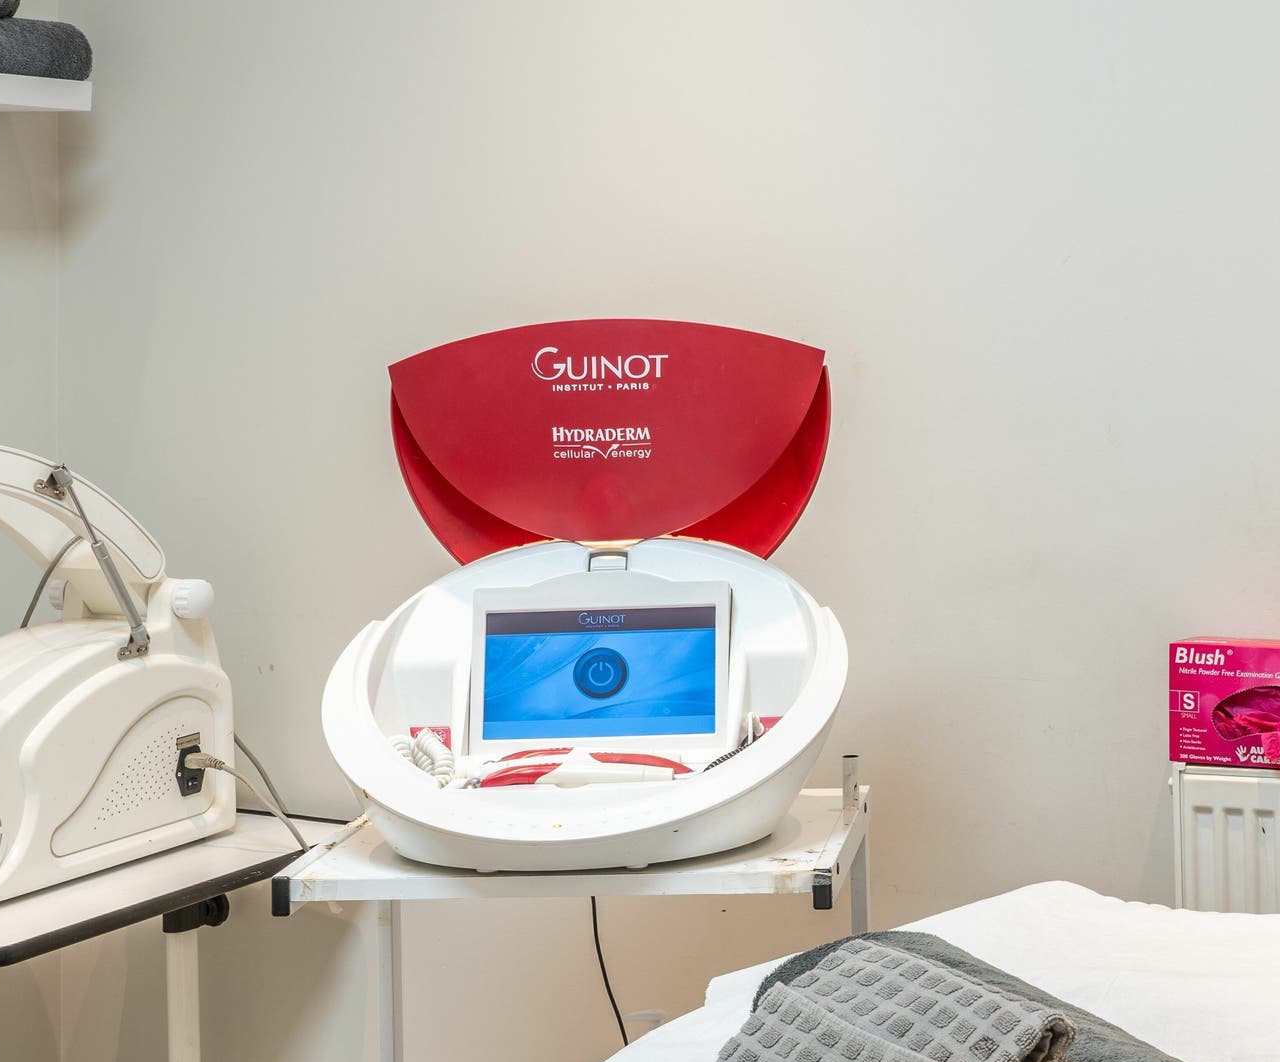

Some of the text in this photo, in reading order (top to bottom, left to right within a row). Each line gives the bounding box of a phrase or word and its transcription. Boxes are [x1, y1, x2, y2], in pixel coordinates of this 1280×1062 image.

[531, 346, 668, 380] GUINOT
[616, 382, 650, 390] PARIS
[551, 426, 651, 442] HYDRADERM
[553, 448, 652, 459] cellular energy
[578, 612, 626, 625] GUINOT
[1178, 667, 1197, 675] Nitrile
[1198, 668, 1220, 676] Powder
[1221, 669, 1235, 677] Free
[1236, 670, 1274, 679] Examination
[1183, 693, 1195, 710] S
